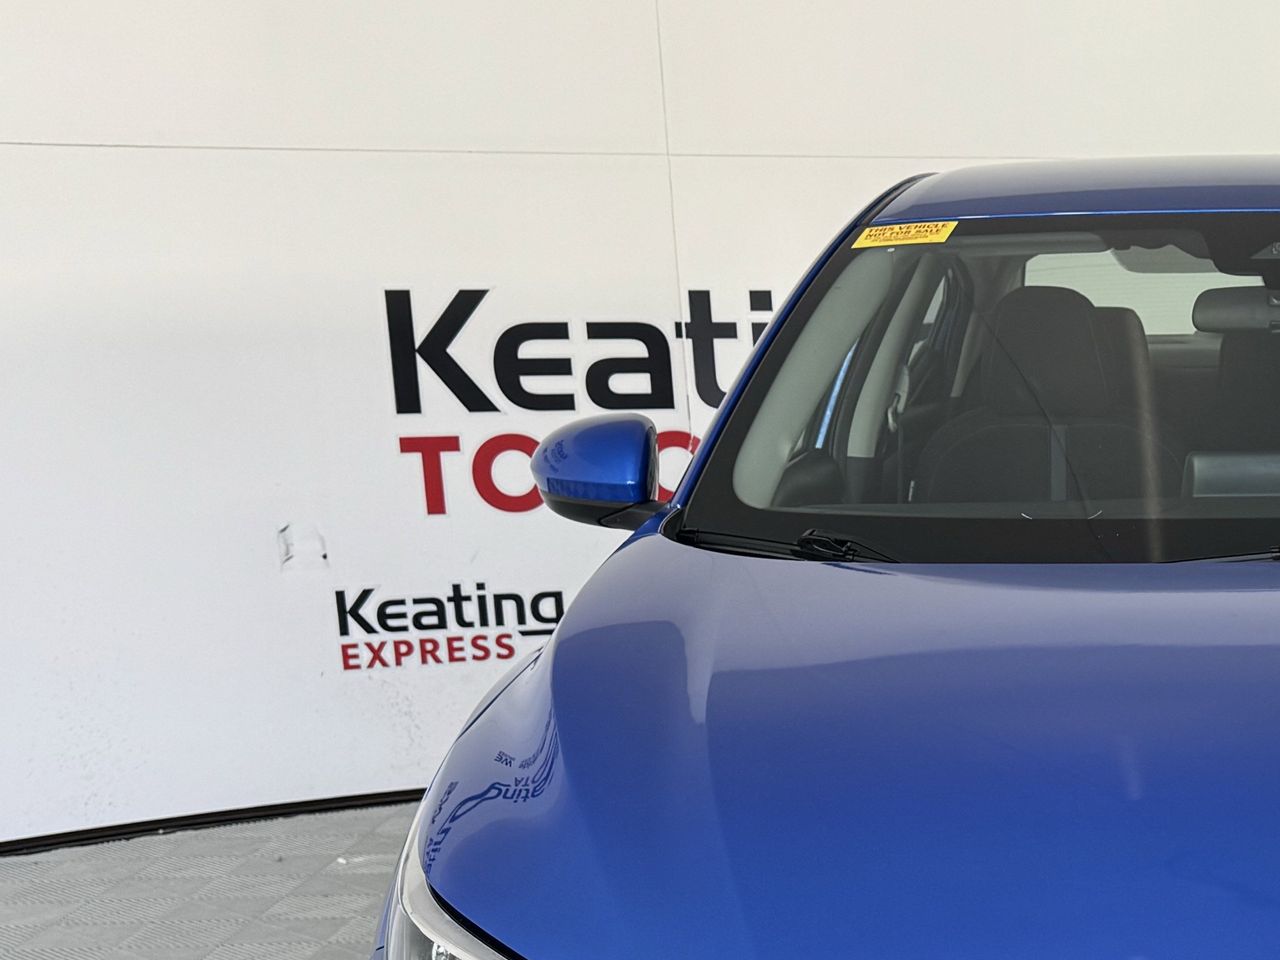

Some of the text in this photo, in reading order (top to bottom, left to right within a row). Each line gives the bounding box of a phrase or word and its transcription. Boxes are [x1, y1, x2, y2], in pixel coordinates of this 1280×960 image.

[898, 223, 949, 231] VEHICLE
[335, 582, 564, 637] Keating
[341, 633, 516, 670] EXPRESS
